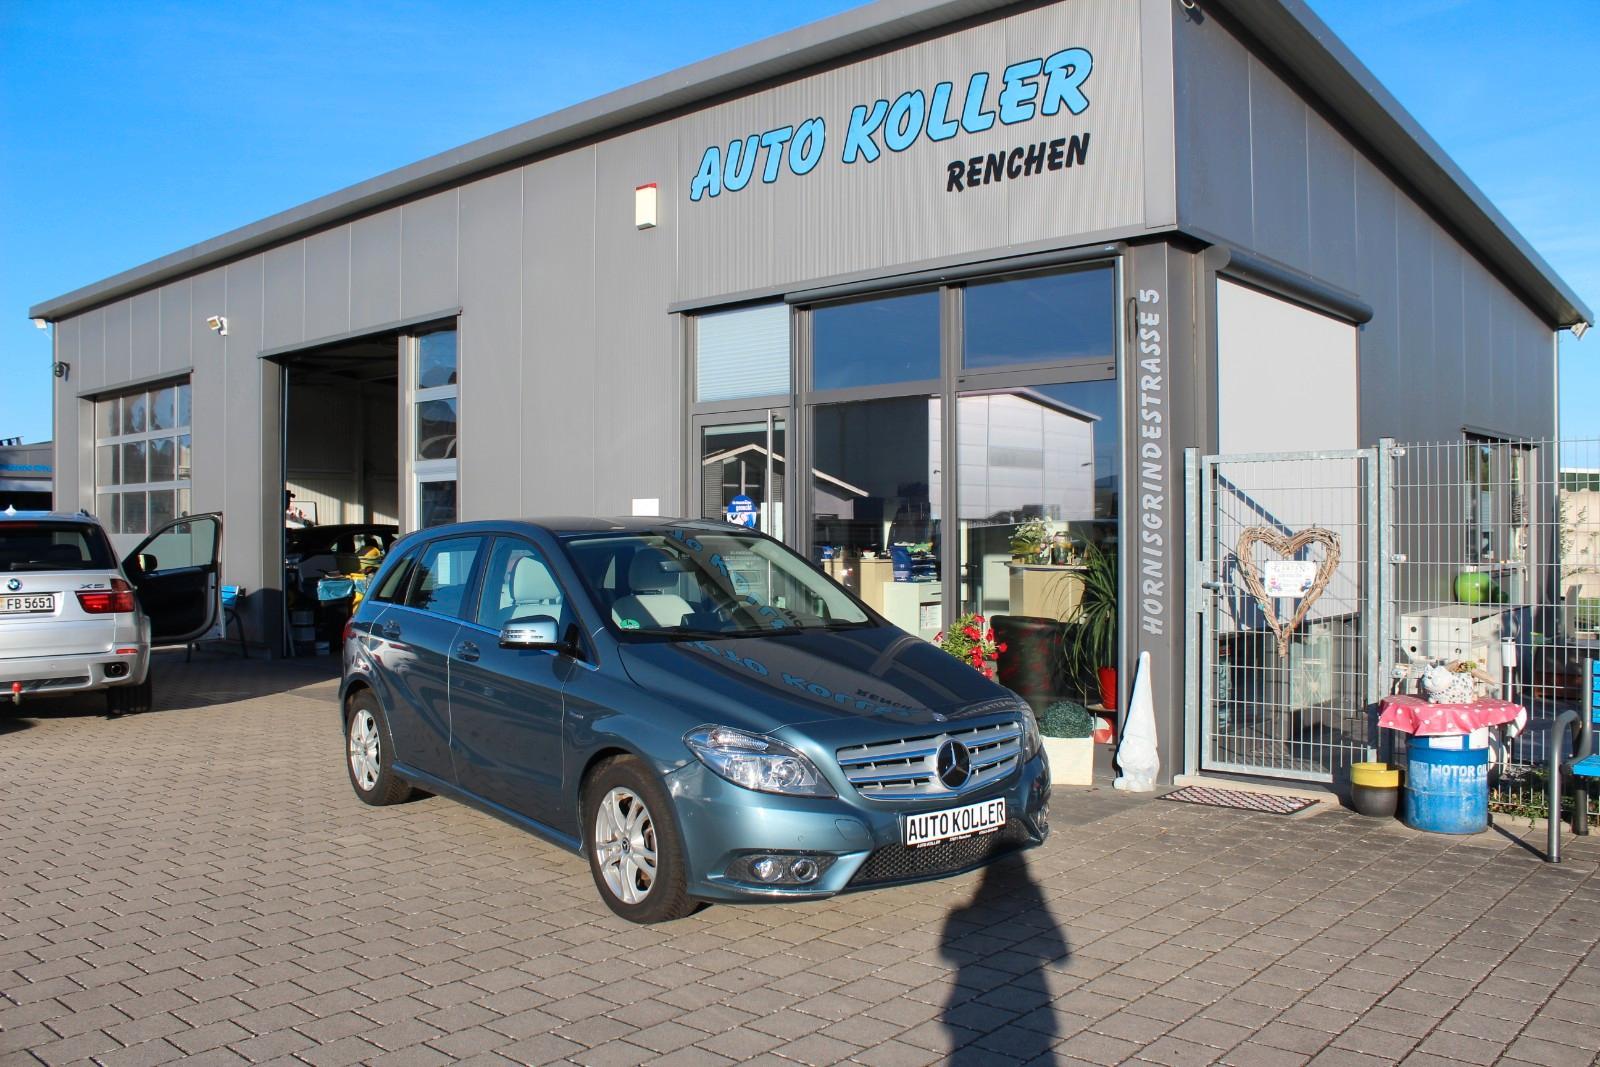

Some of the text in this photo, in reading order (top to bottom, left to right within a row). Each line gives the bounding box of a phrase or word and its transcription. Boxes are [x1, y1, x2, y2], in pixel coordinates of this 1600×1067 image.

[690, 46, 1094, 202] AUTO KOLLER
[946, 132, 1091, 193] RENCHEN
[1139, 289, 1165, 635] HORNISGRINDESTRASSE 5
[7, 597, 53, 610] FB 5651
[1430, 763, 1476, 778] MOTOR
[908, 801, 1004, 842] AUTO KOLLER
